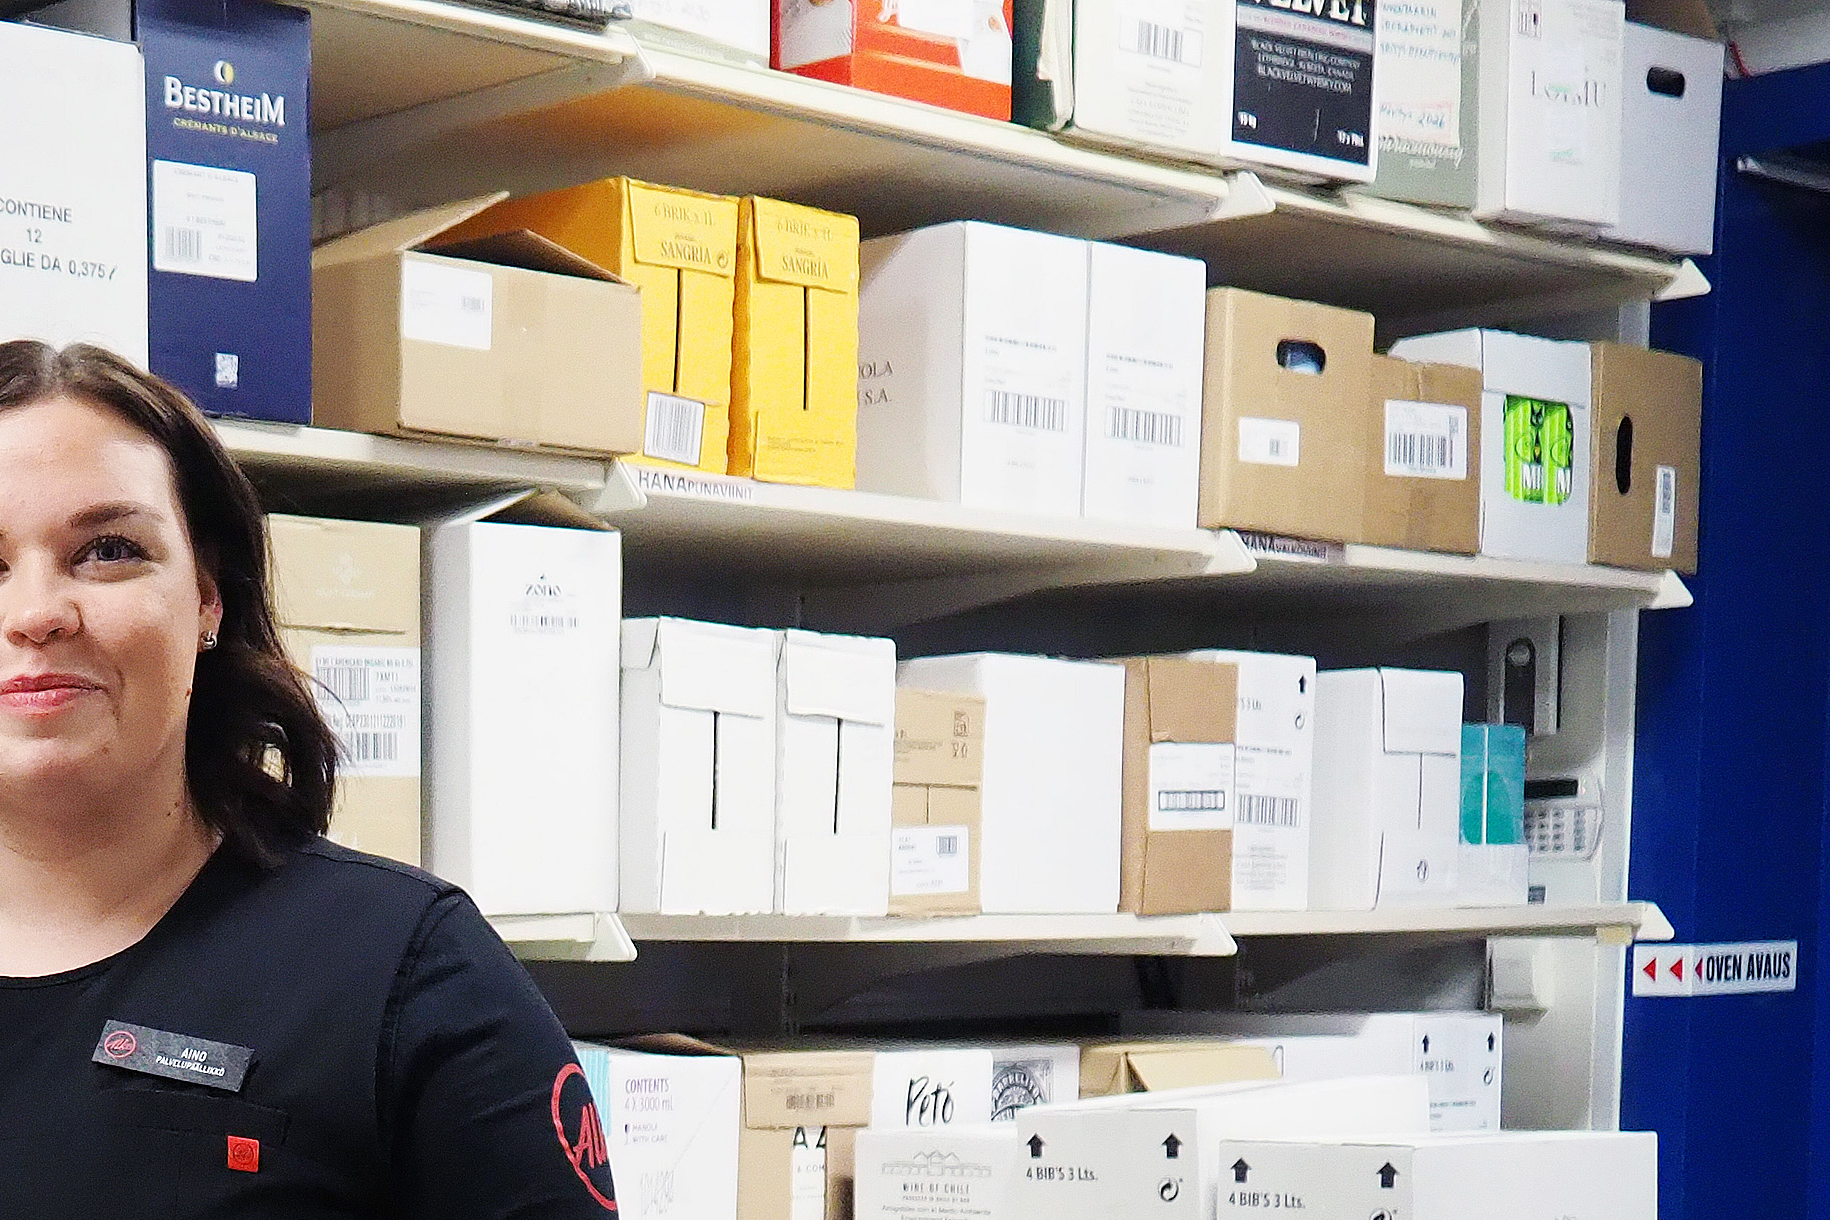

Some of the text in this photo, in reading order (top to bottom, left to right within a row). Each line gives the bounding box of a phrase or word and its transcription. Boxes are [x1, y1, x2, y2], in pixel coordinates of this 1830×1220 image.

[163, 75, 286, 127] BESTHEIM
[664, 204, 693, 222] BRIK
[26, 227, 43, 245] 12
[660, 242, 712, 266] SANGRIA
[40, 253, 63, 274] DA
[68, 259, 106, 281] 0,375
[782, 257, 828, 280] SANGRIA
[1706, 951, 1791, 982] OVEN AVAUS
[181, 1047, 208, 1062] AINO
[625, 1078, 670, 1094] CONTENTS
[624, 1096, 661, 1112] 4 3000
[1026, 1167, 1033, 1181] 4
[1067, 1167, 1075, 1182] 3
[1078, 1166, 1099, 1182] Lts.
[1229, 1192, 1236, 1207] 4
[1272, 1193, 1282, 1209] 3
[1284, 1194, 1306, 1210] Lts.
